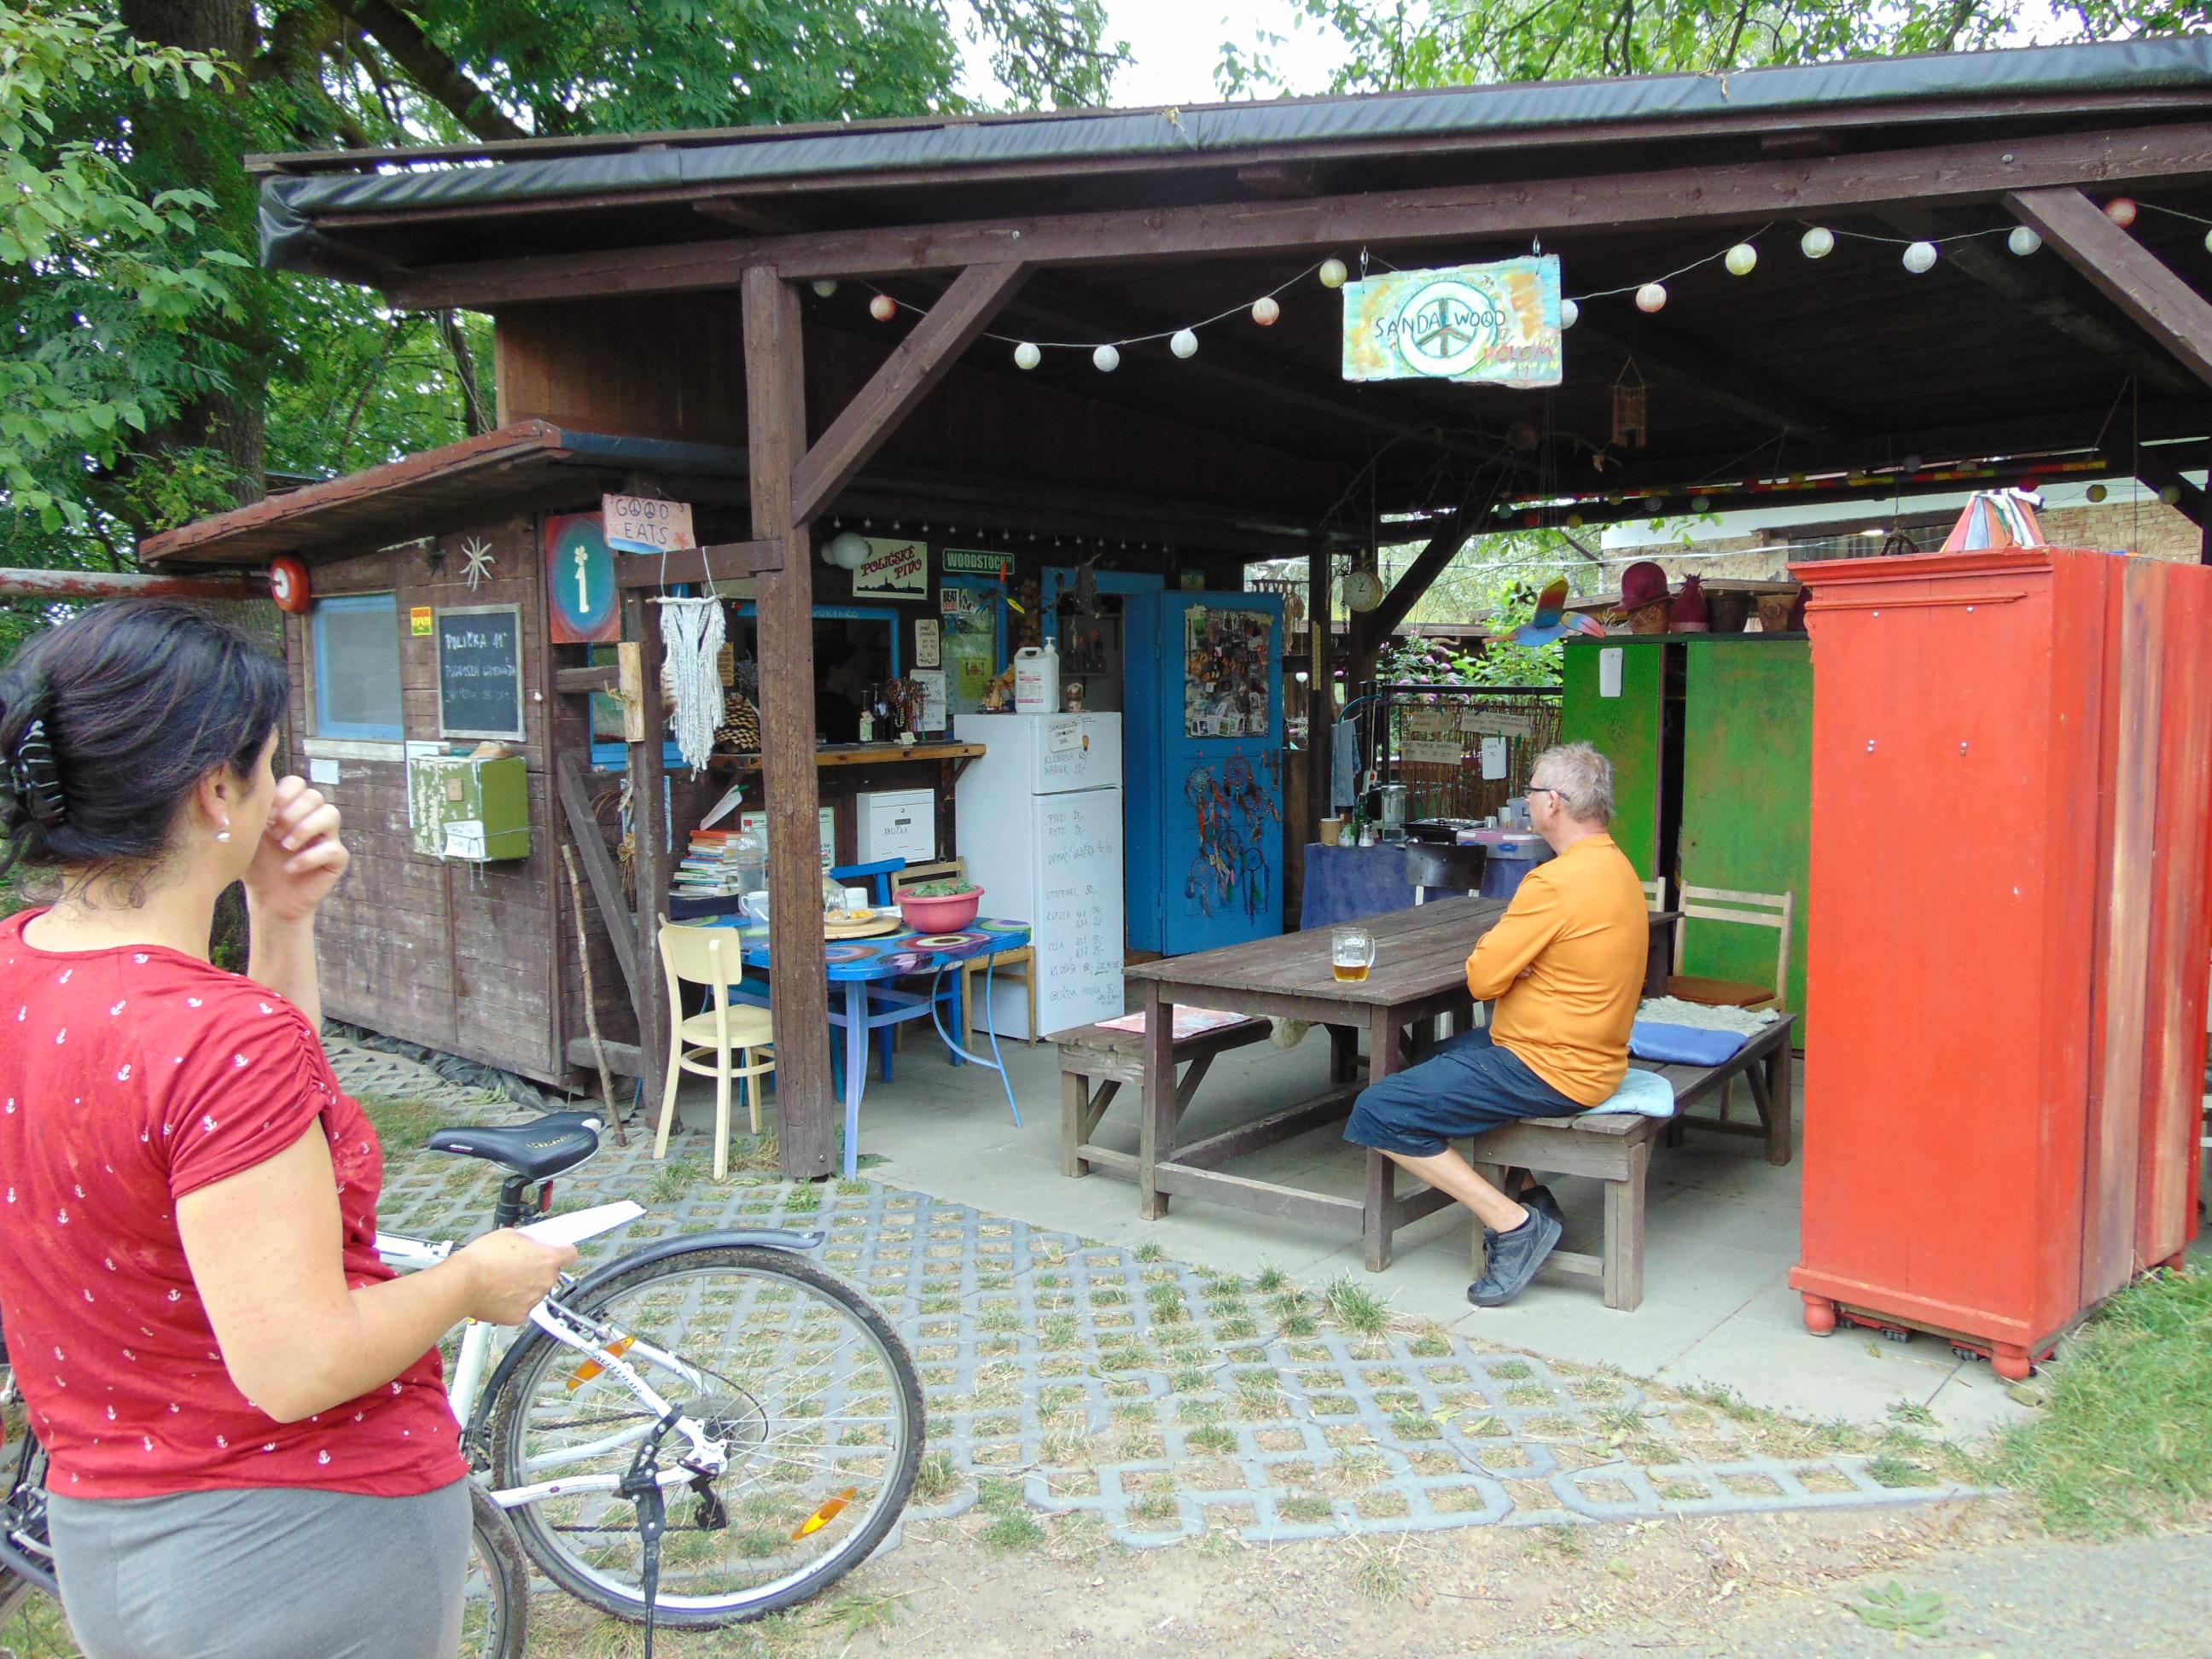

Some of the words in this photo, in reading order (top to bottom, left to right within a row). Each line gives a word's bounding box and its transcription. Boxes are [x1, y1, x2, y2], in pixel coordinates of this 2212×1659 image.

[615, 498, 670, 520] GOOD
[624, 521, 670, 544] EATS
[860, 544, 917, 578] POLIČSKÉ
[894, 557, 923, 580] PIVO
